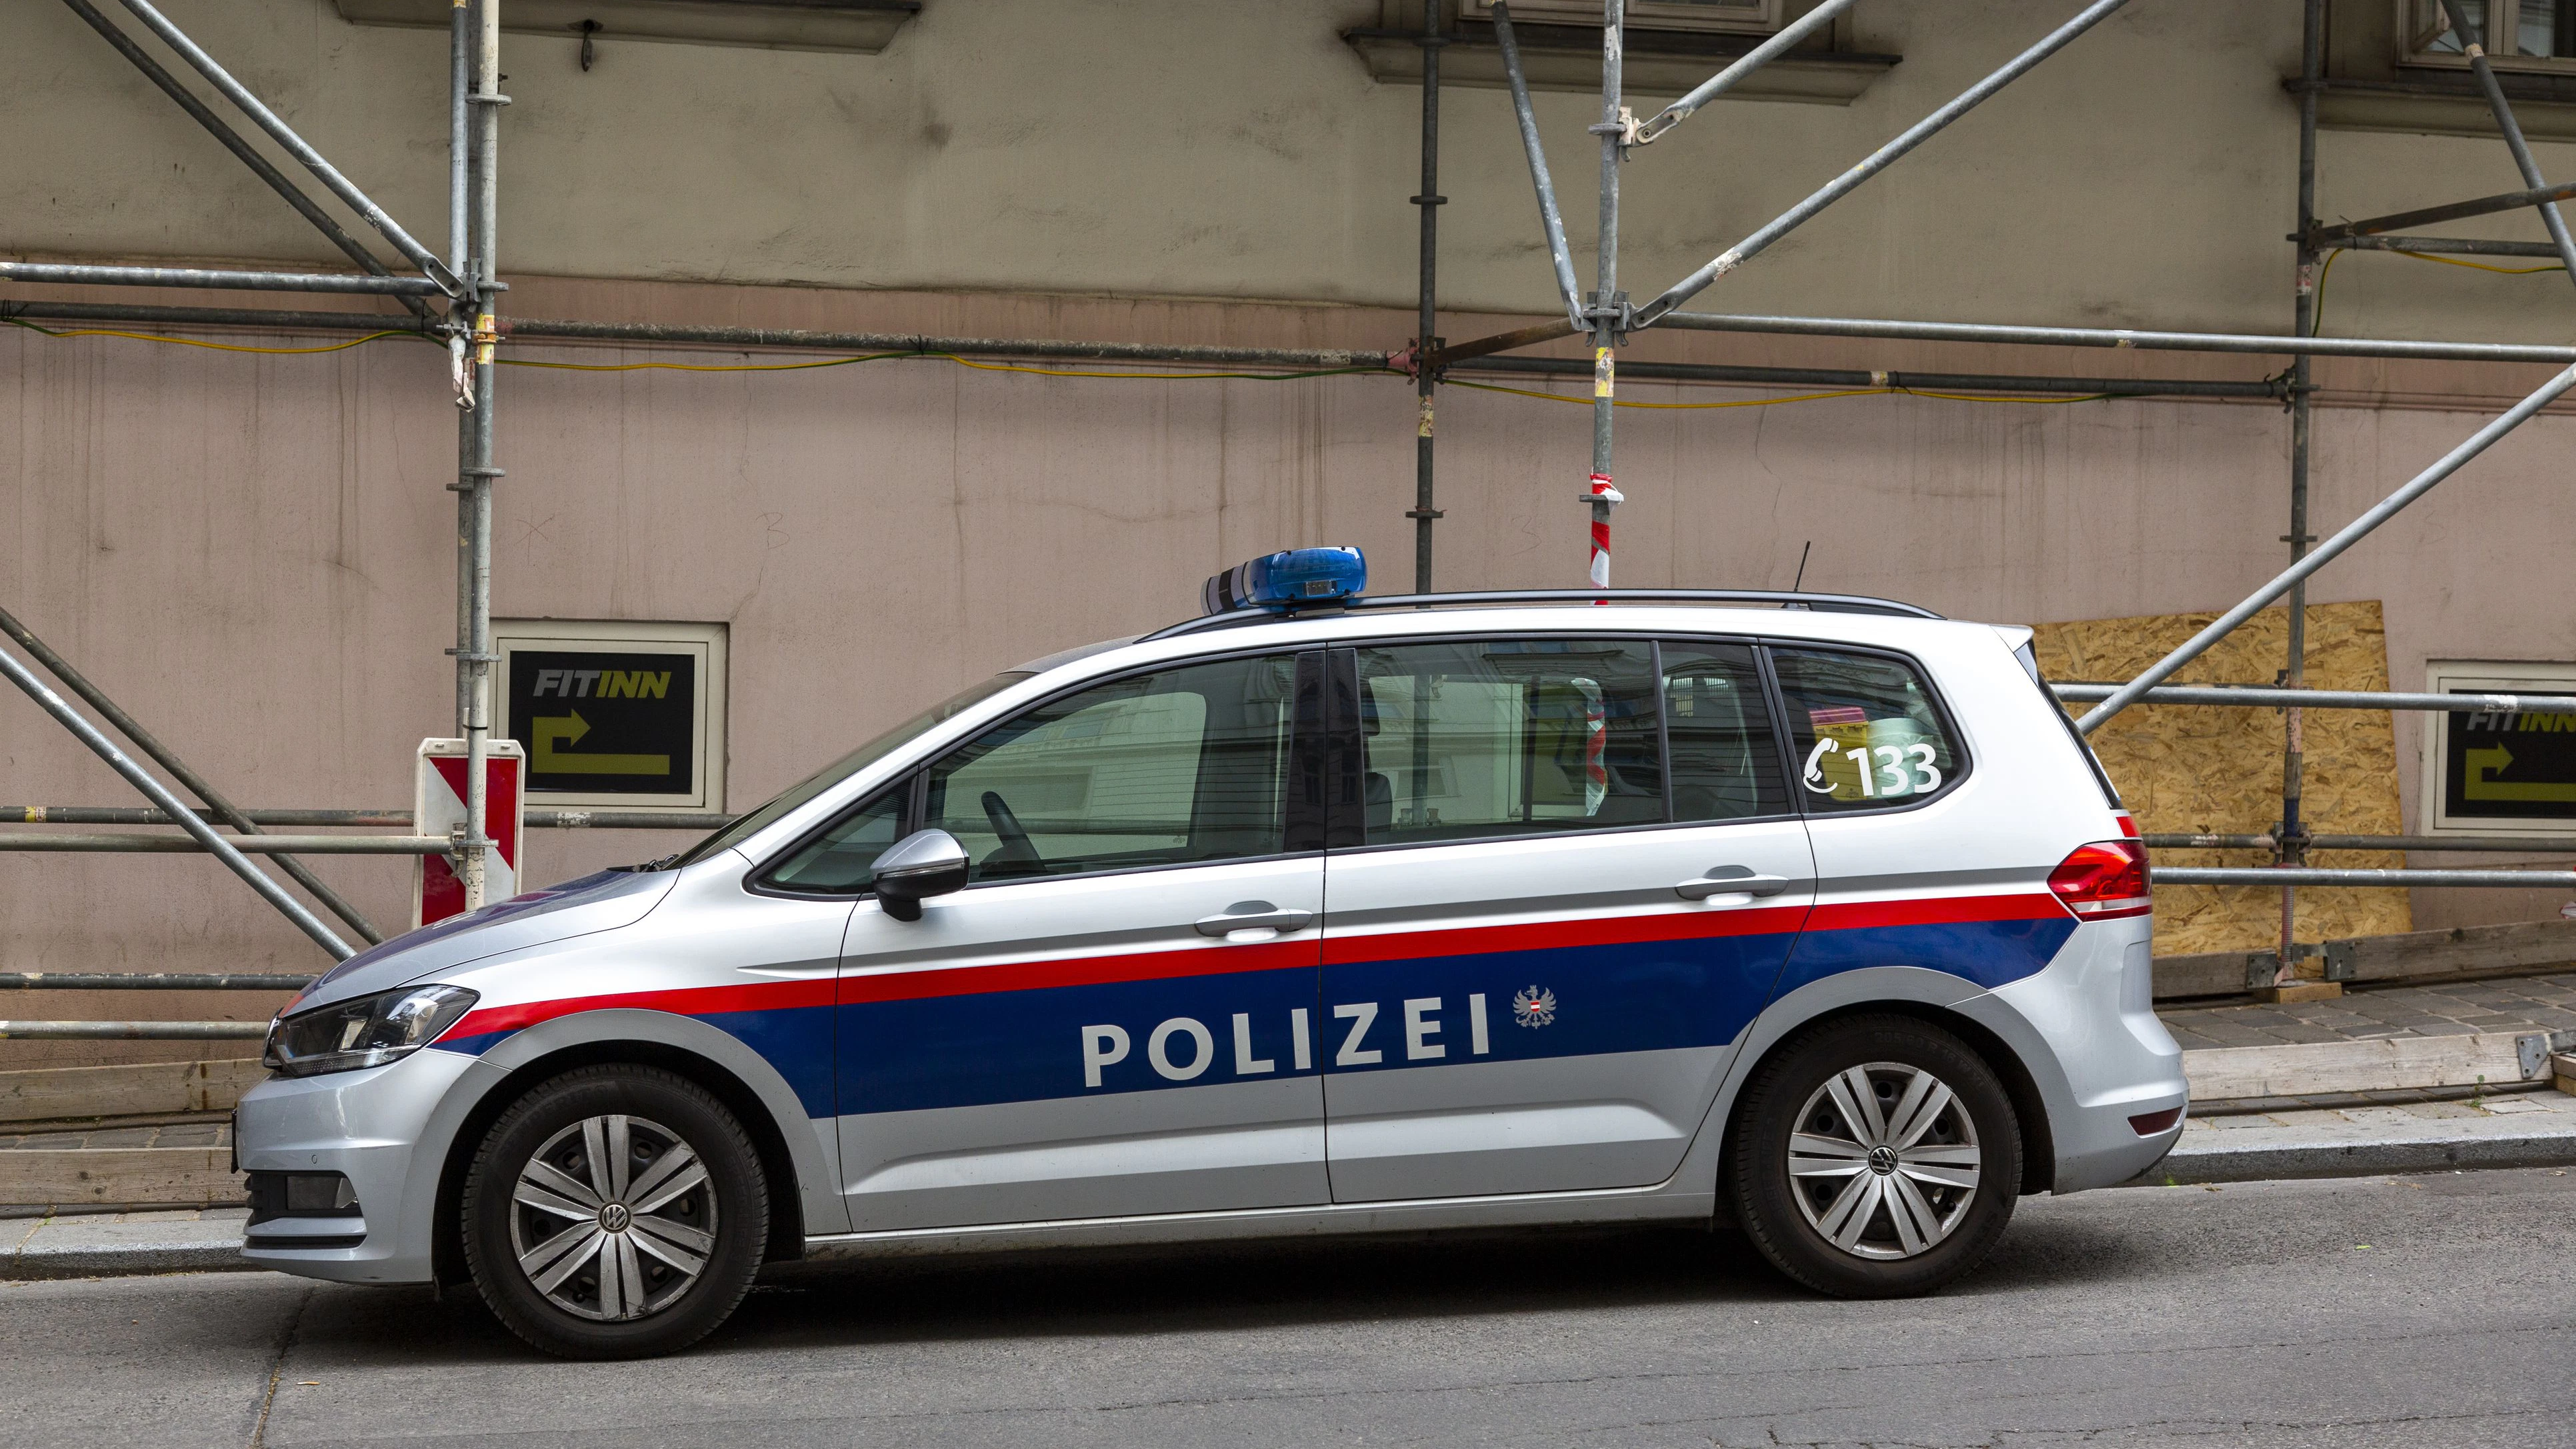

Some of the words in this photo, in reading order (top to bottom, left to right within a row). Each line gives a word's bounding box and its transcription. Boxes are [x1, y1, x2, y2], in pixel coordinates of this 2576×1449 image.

[533, 669, 672, 699] FITINN
[1845, 743, 1942, 796] 133
[1081, 993, 1489, 1088] POLIZEI
